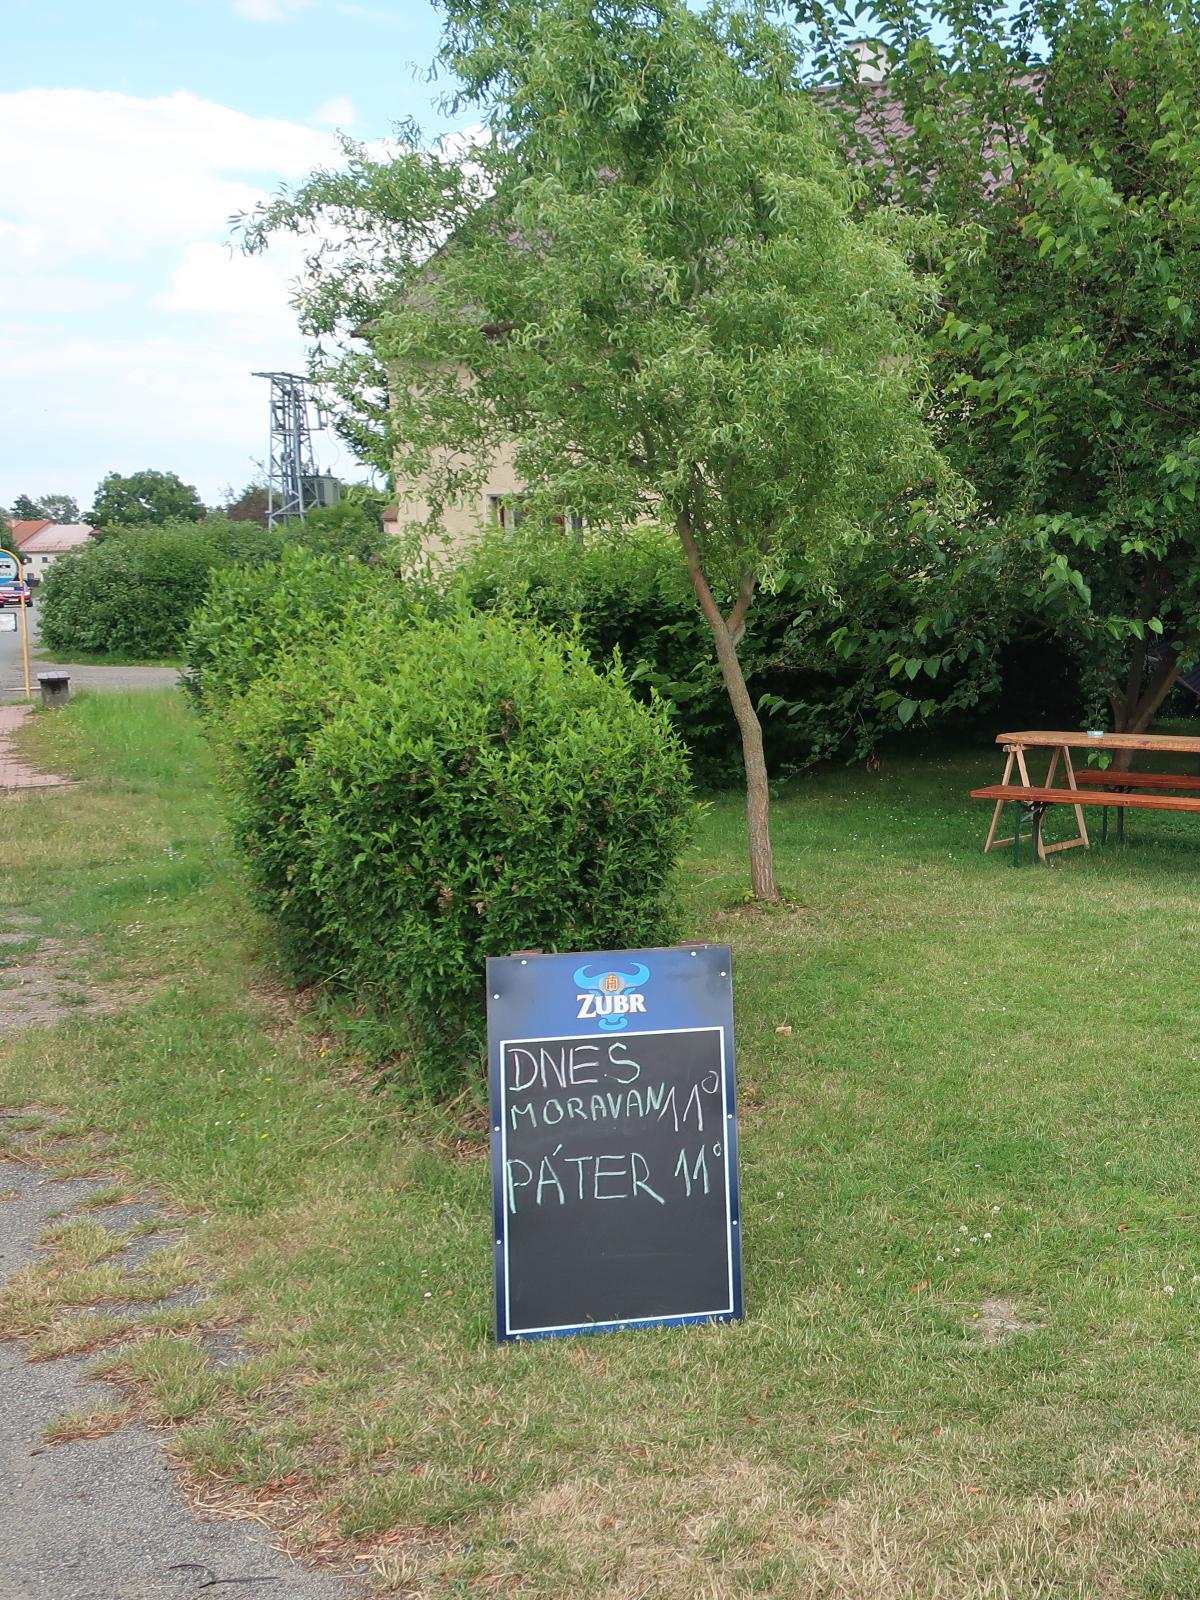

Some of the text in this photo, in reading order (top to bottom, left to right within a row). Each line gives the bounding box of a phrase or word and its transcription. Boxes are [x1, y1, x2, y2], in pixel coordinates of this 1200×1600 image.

[576, 993, 647, 1019] ZUBR
[508, 1042, 641, 1091] DNES
[510, 1082, 665, 1131] MORAVAN
[506, 1143, 665, 1214] PÁTER
